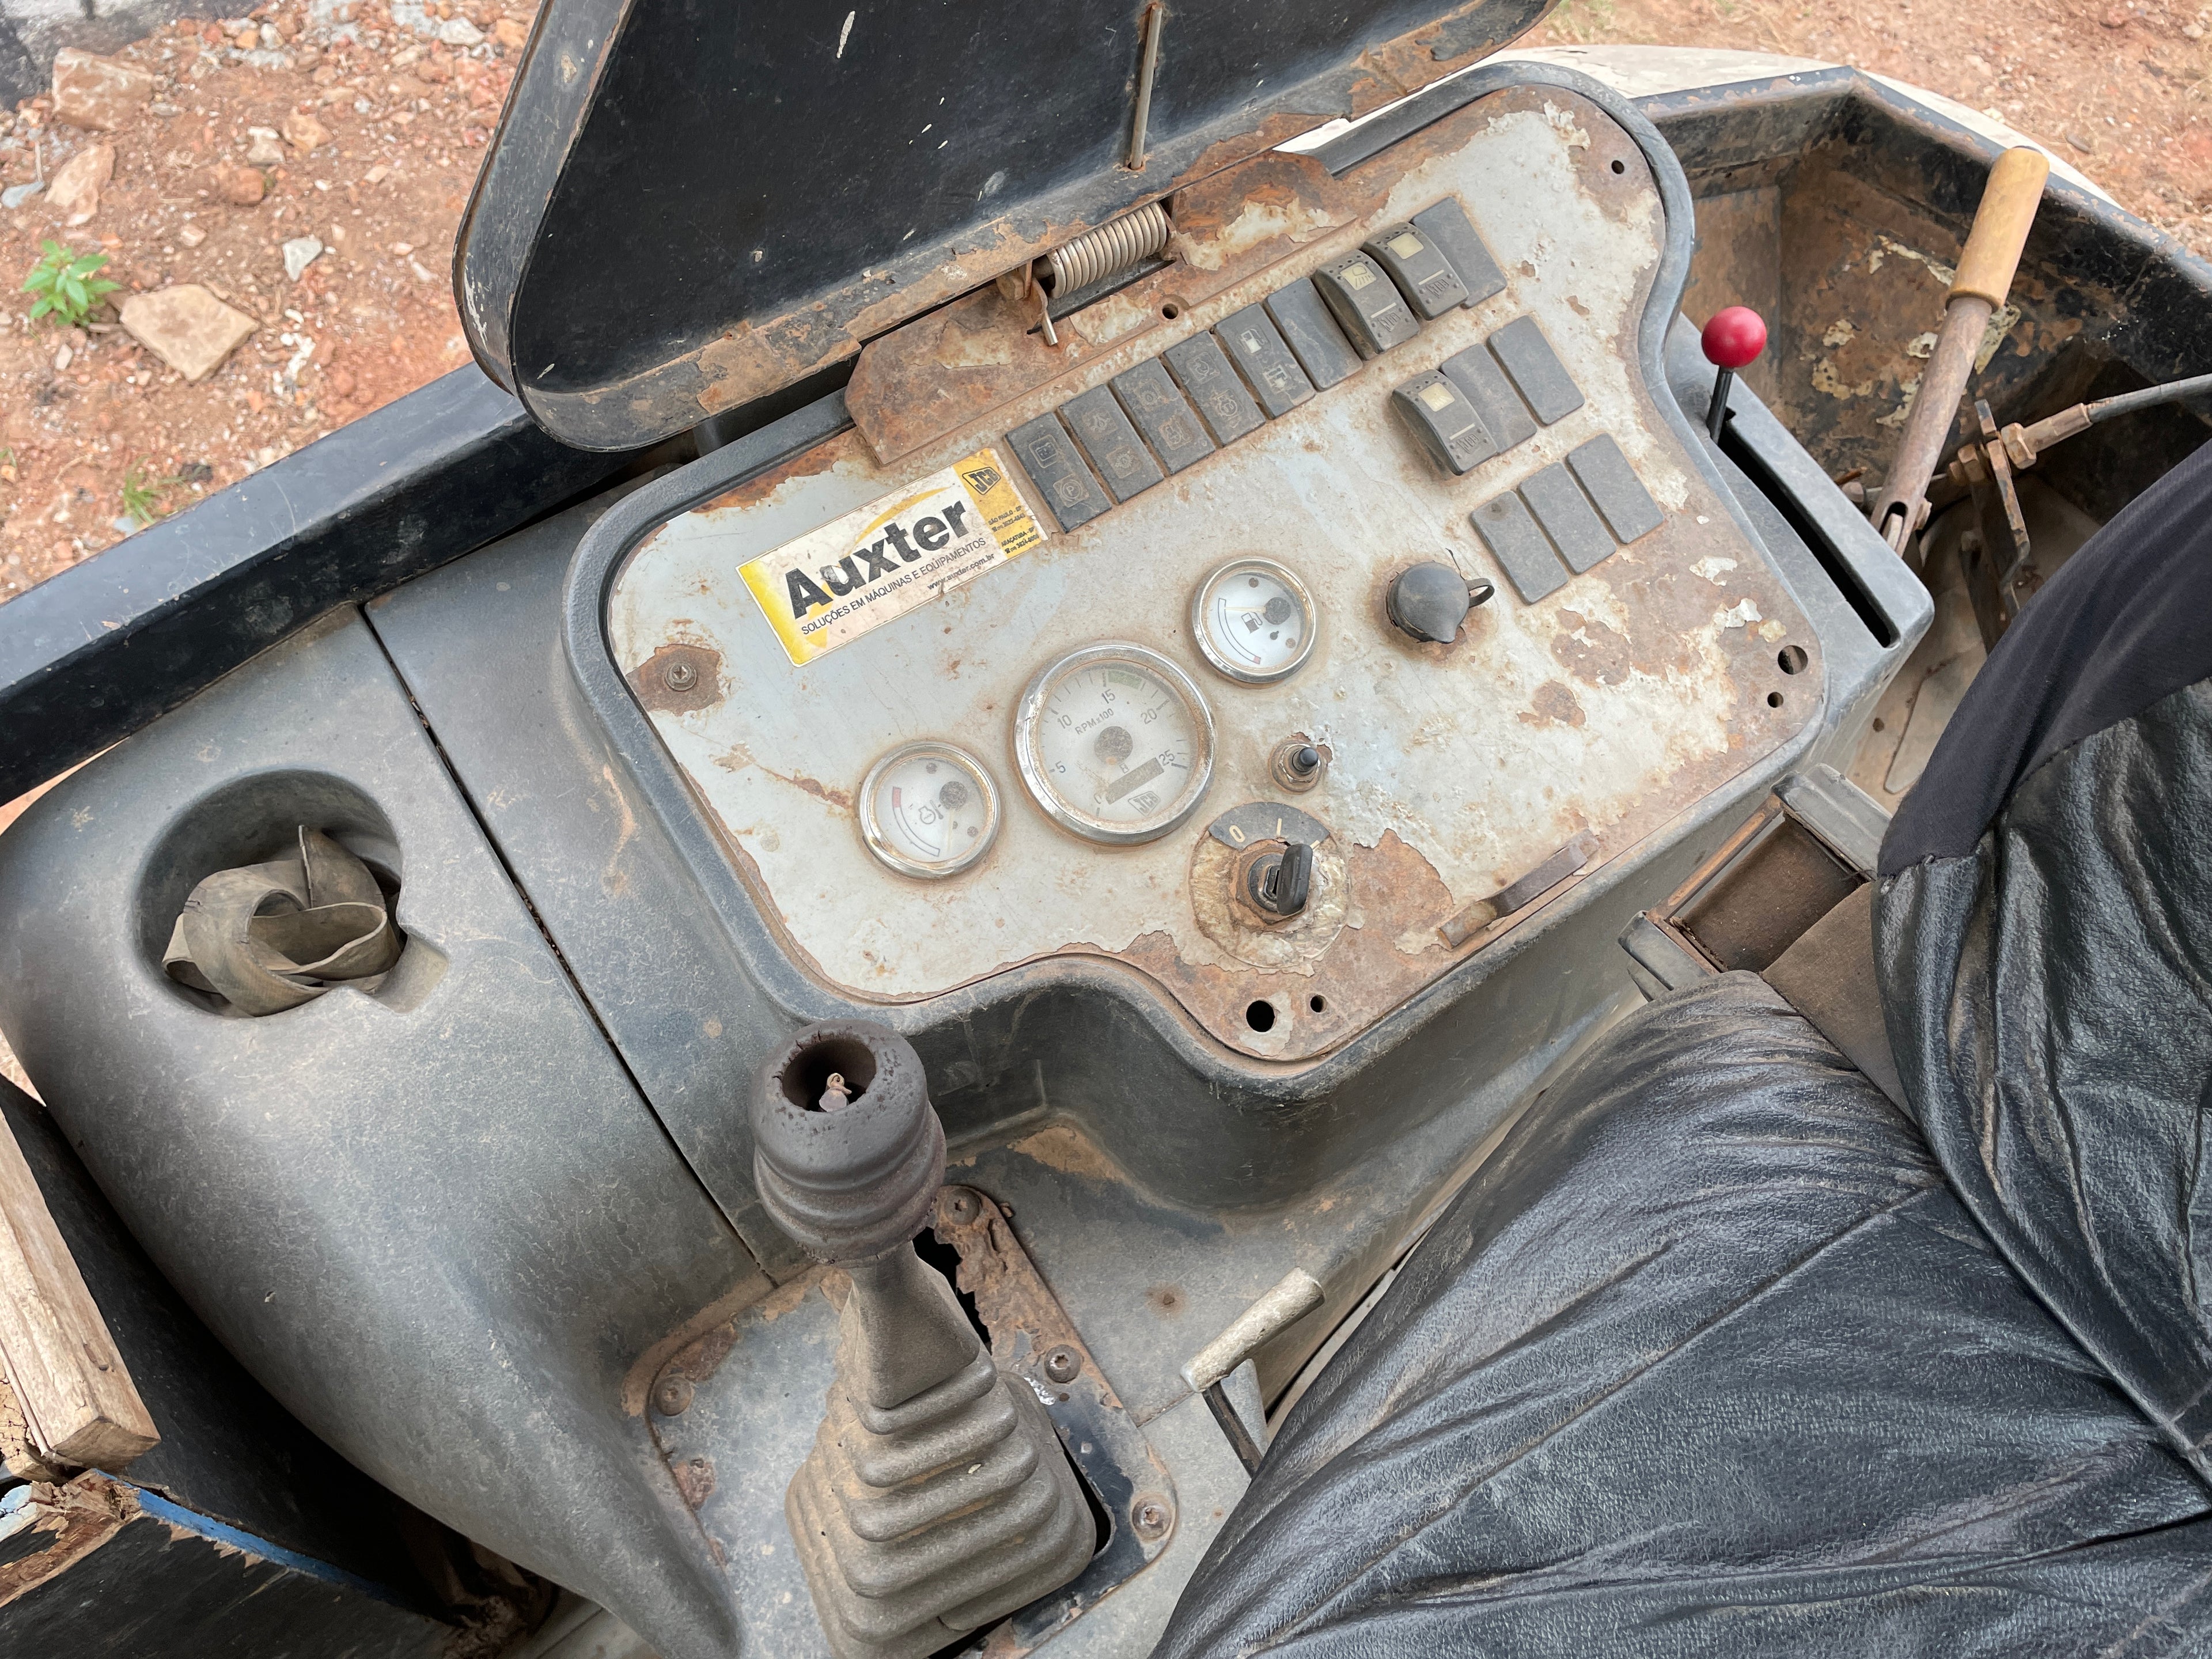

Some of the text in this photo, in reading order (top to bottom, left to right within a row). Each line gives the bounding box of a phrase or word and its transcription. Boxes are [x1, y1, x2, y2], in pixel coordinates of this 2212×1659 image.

[968, 469, 998, 492] JCB
[998, 510, 1013, 521] PAULO
[1001, 531, 1027, 547] ARAÇATUBA
[784, 501, 968, 619] Auxter
[927, 552, 994, 590] www.auxter.com.br
[801, 537, 986, 635] SOLUÇÕES EM MÁQUINAS E EQUIPAMENTOS
[1101, 689, 1116, 704] 15
[1057, 714, 1072, 729] 10
[1141, 708, 1157, 725] 20
[1158, 749, 1175, 766] 25
[1055, 761, 1066, 774] 5
[1132, 793, 1158, 813] JCB
